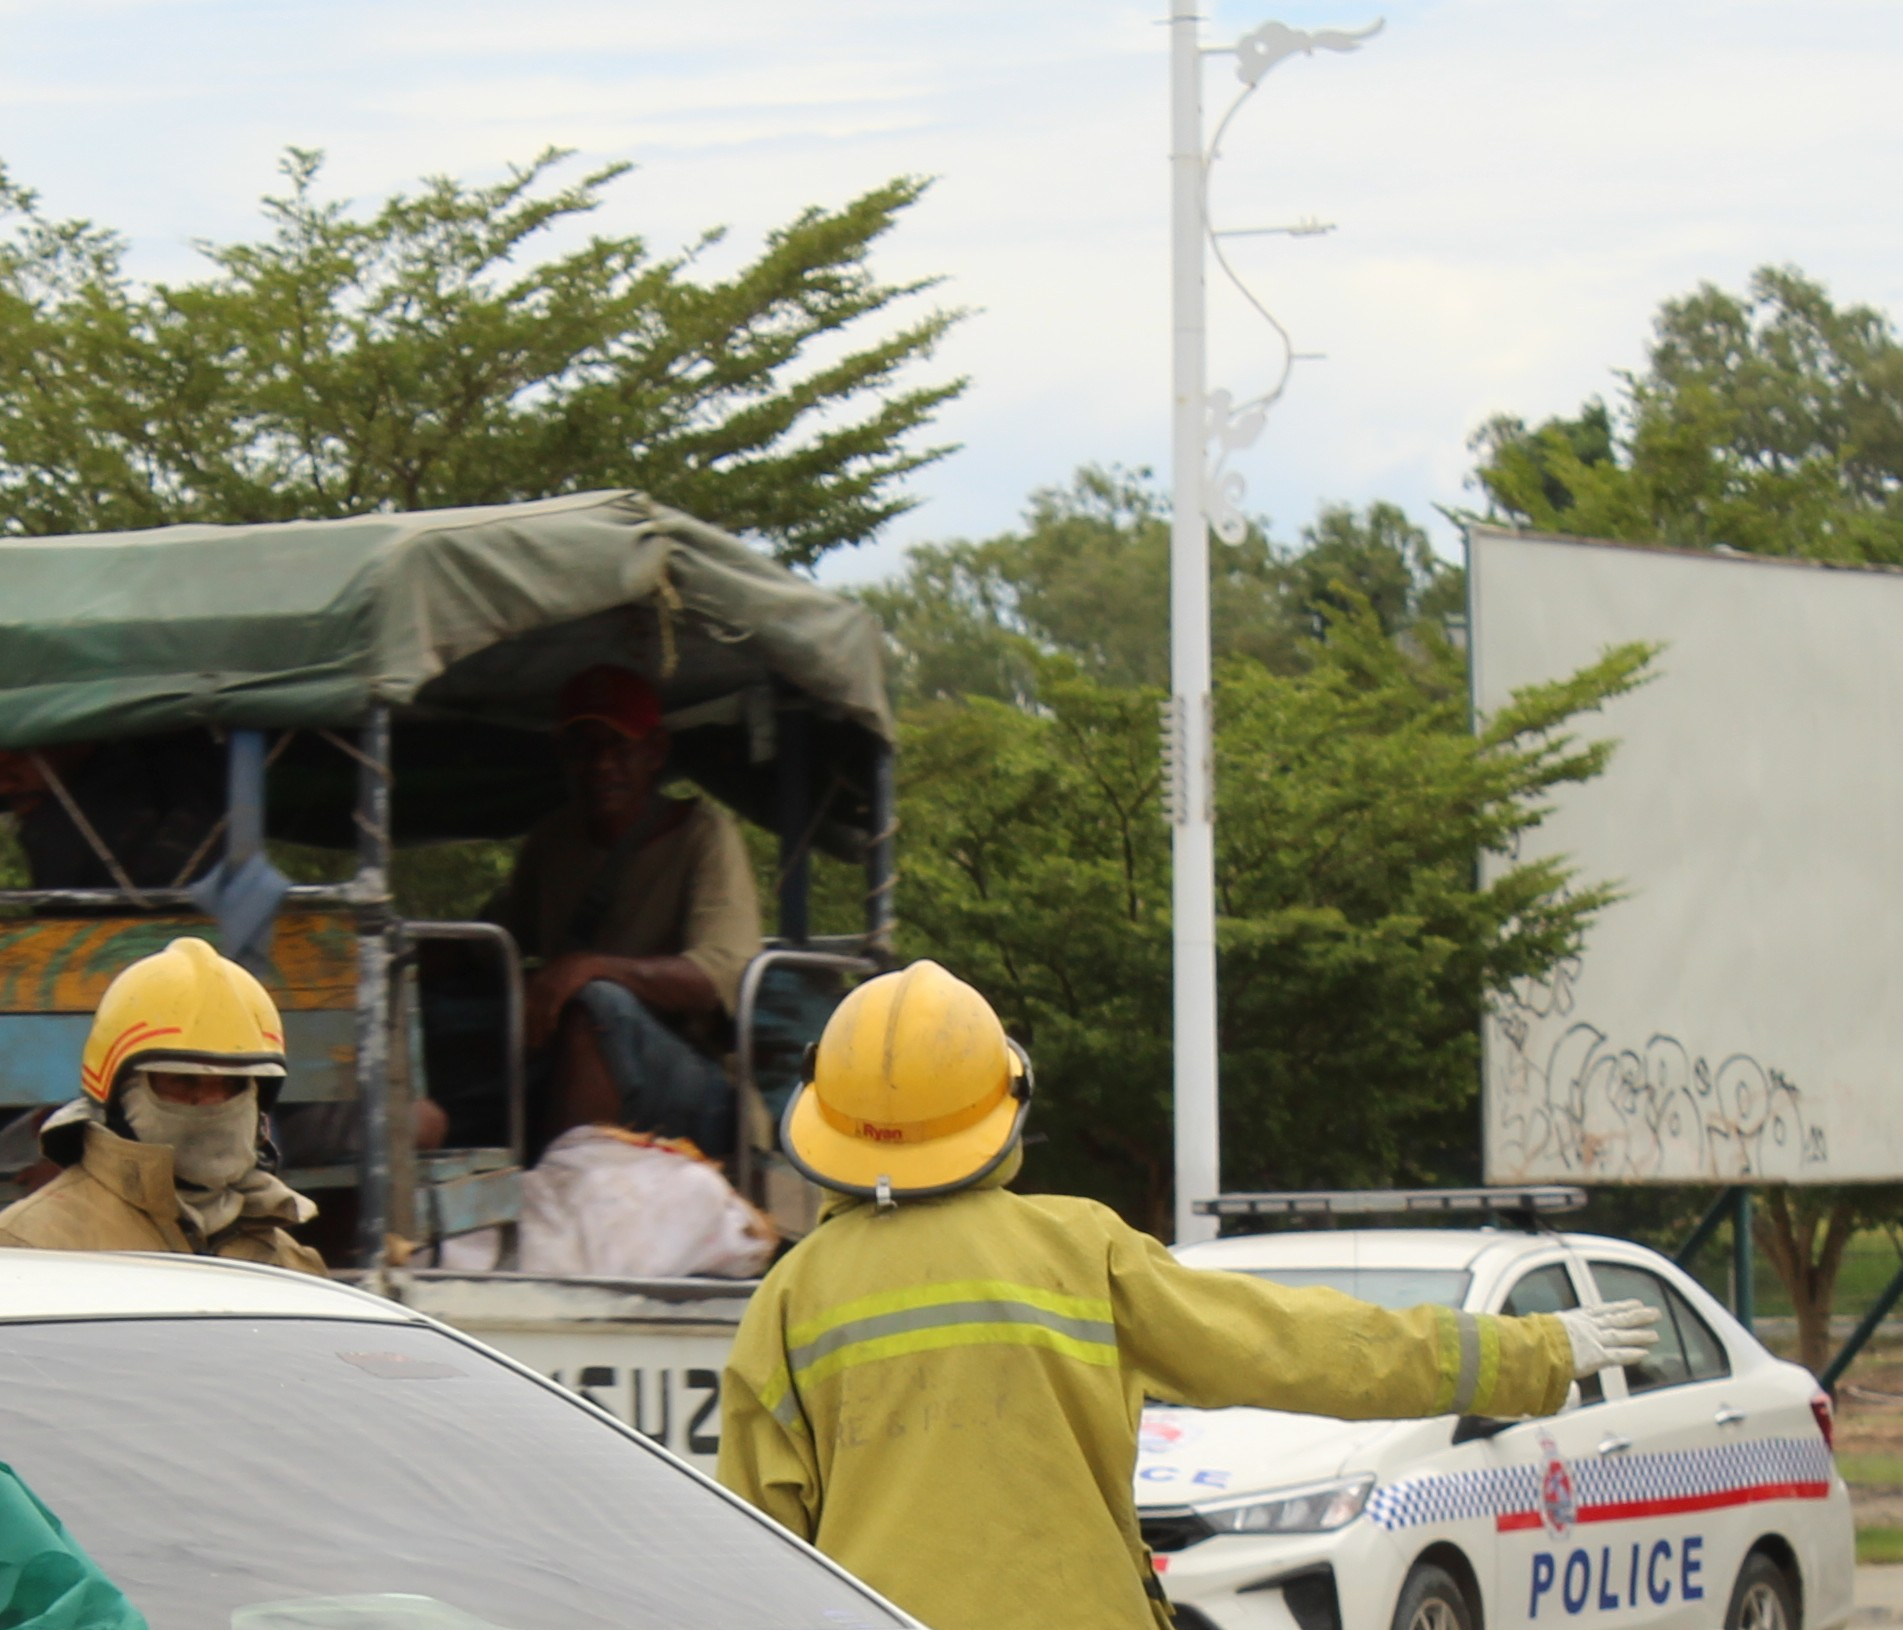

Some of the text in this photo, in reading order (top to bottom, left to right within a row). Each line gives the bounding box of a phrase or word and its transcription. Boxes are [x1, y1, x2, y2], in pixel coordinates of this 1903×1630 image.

[863, 1122, 903, 1142] Ryan
[549, 1367, 721, 1454] SUZ
[1528, 1535, 1705, 1620] POLICE
